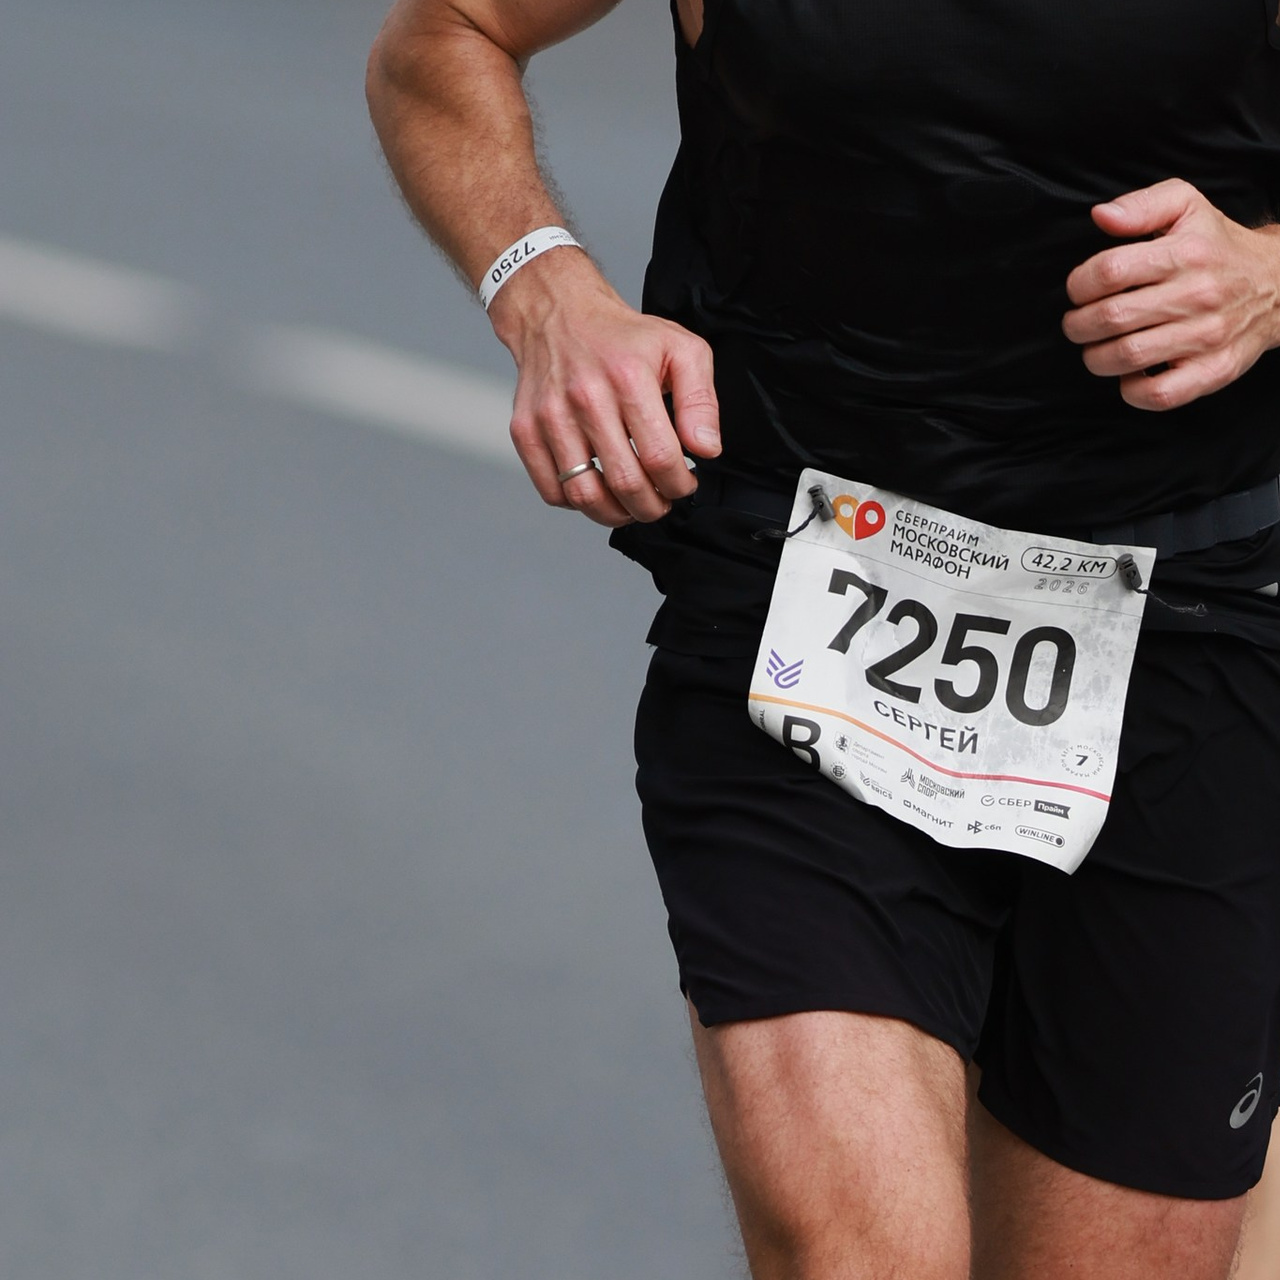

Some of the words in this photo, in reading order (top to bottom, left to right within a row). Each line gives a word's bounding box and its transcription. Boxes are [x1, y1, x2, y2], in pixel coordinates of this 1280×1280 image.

[491, 241, 536, 283] 7250
[895, 509, 980, 547] СБЕРПРАЙМ
[893, 523, 1010, 571] МОСКОВСКИЙ
[890, 539, 972, 580] МАРАФОН
[1031, 553, 1073, 572] 42,2
[1076, 560, 1108, 574] КМ
[1033, 578, 1090, 595] 2026
[826, 568, 1077, 727] 7250
[873, 700, 979, 755] СЕРГЕЙ
[1075, 754, 1089, 767] 7
[916, 783, 938, 801] СПОРТ
[919, 774, 966, 799] МОСКОВСКИЙ
[998, 797, 1033, 808] СБЕР
[1036, 802, 1065, 815] Прайм
[984, 823, 1002, 831] сбп
[1018, 827, 1056, 843] WINLINE
